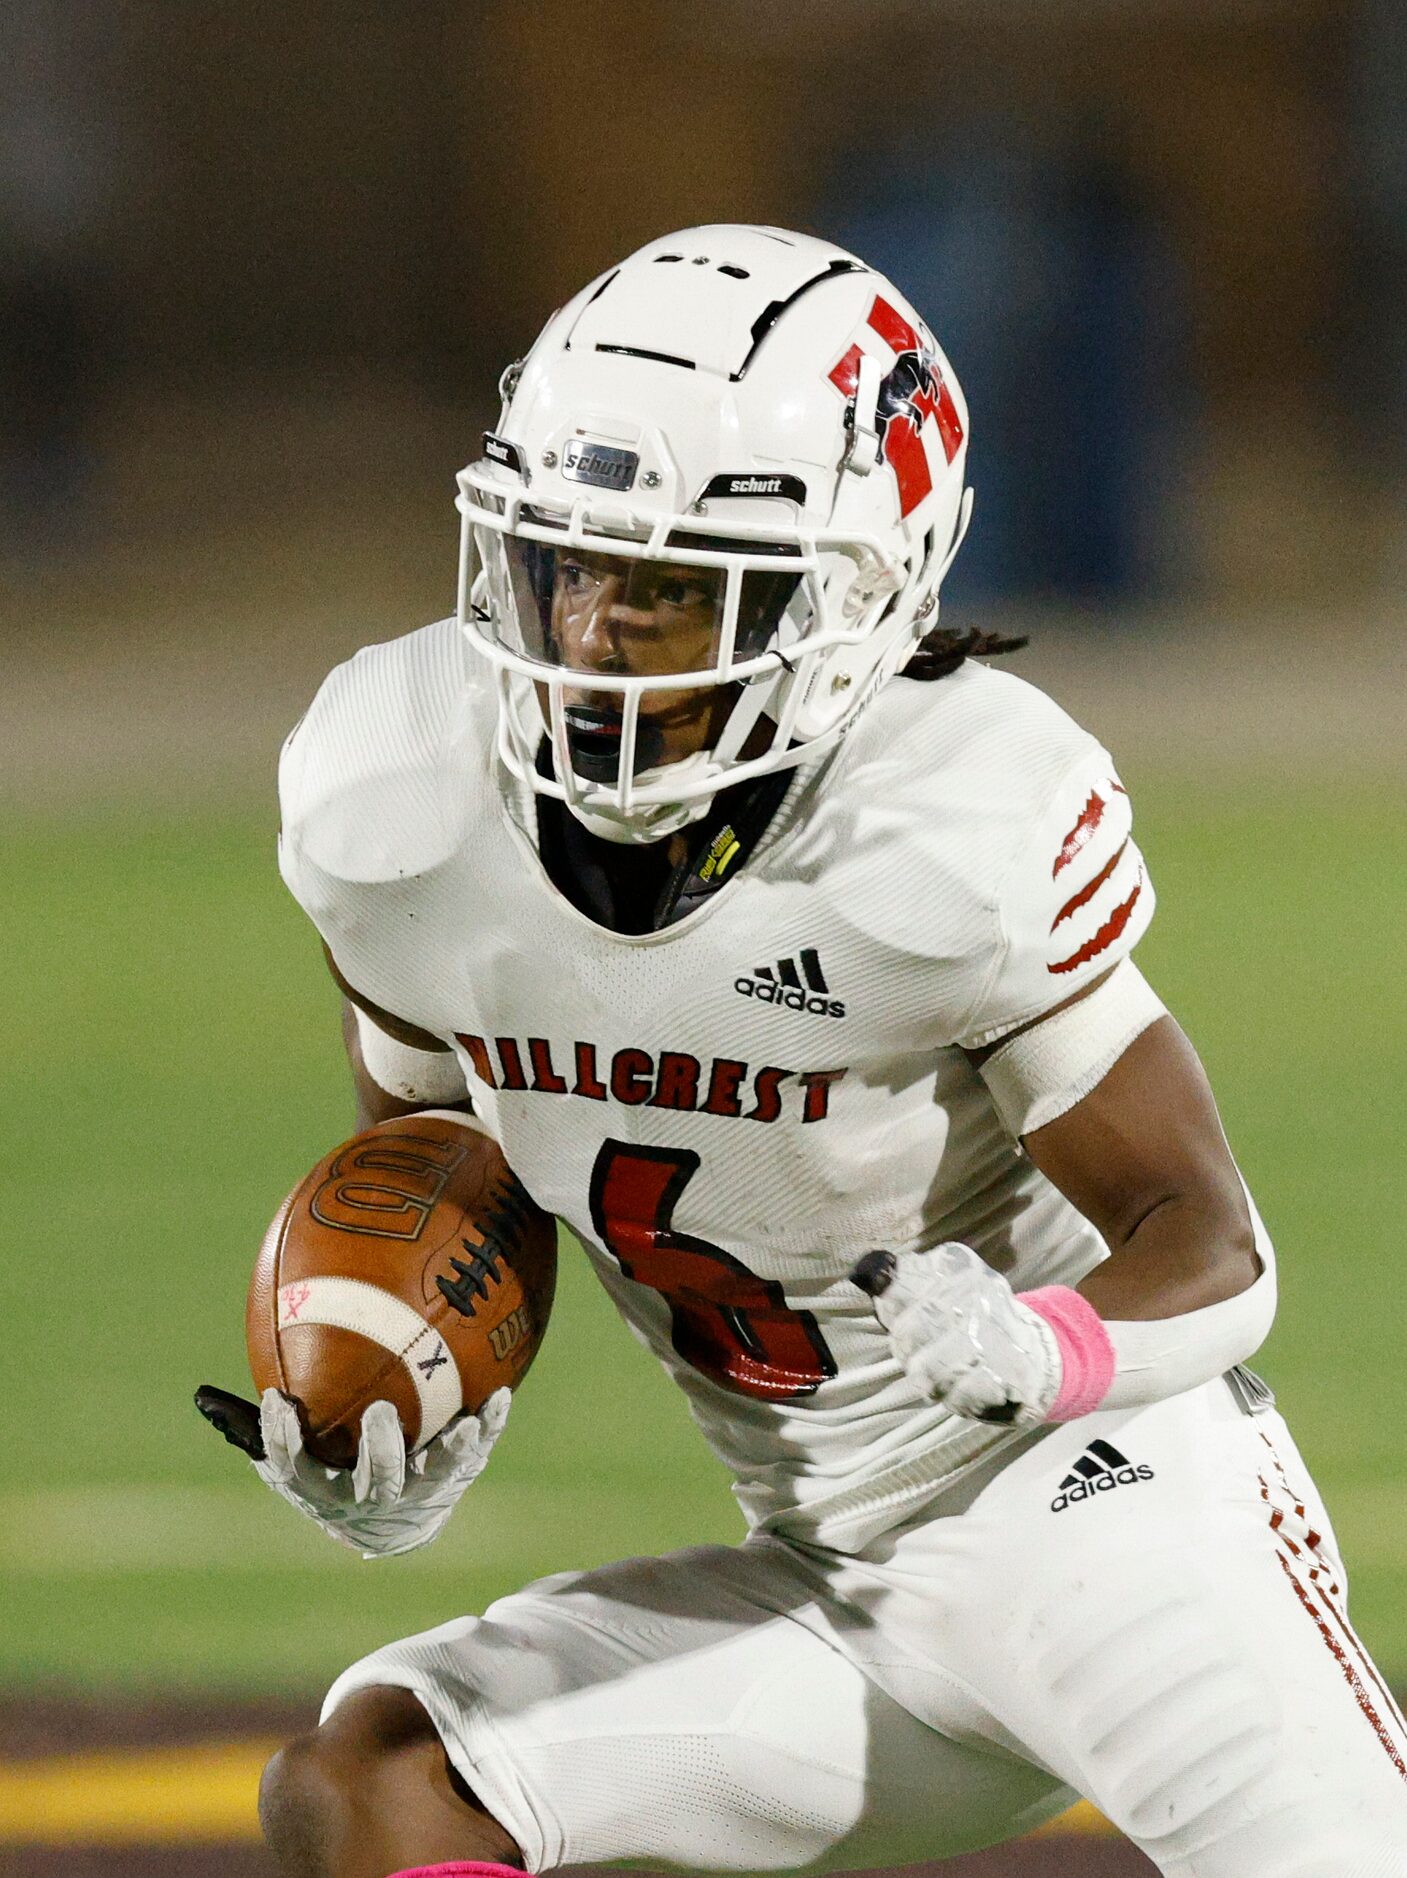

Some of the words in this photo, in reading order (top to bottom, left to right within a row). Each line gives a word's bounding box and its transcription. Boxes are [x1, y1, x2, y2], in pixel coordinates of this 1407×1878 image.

[564, 453, 633, 480] schutt
[729, 477, 783, 493] schutt
[734, 977, 846, 1019] adidas
[588, 1136, 839, 1400] 6
[1050, 1464, 1155, 1513] adidas
